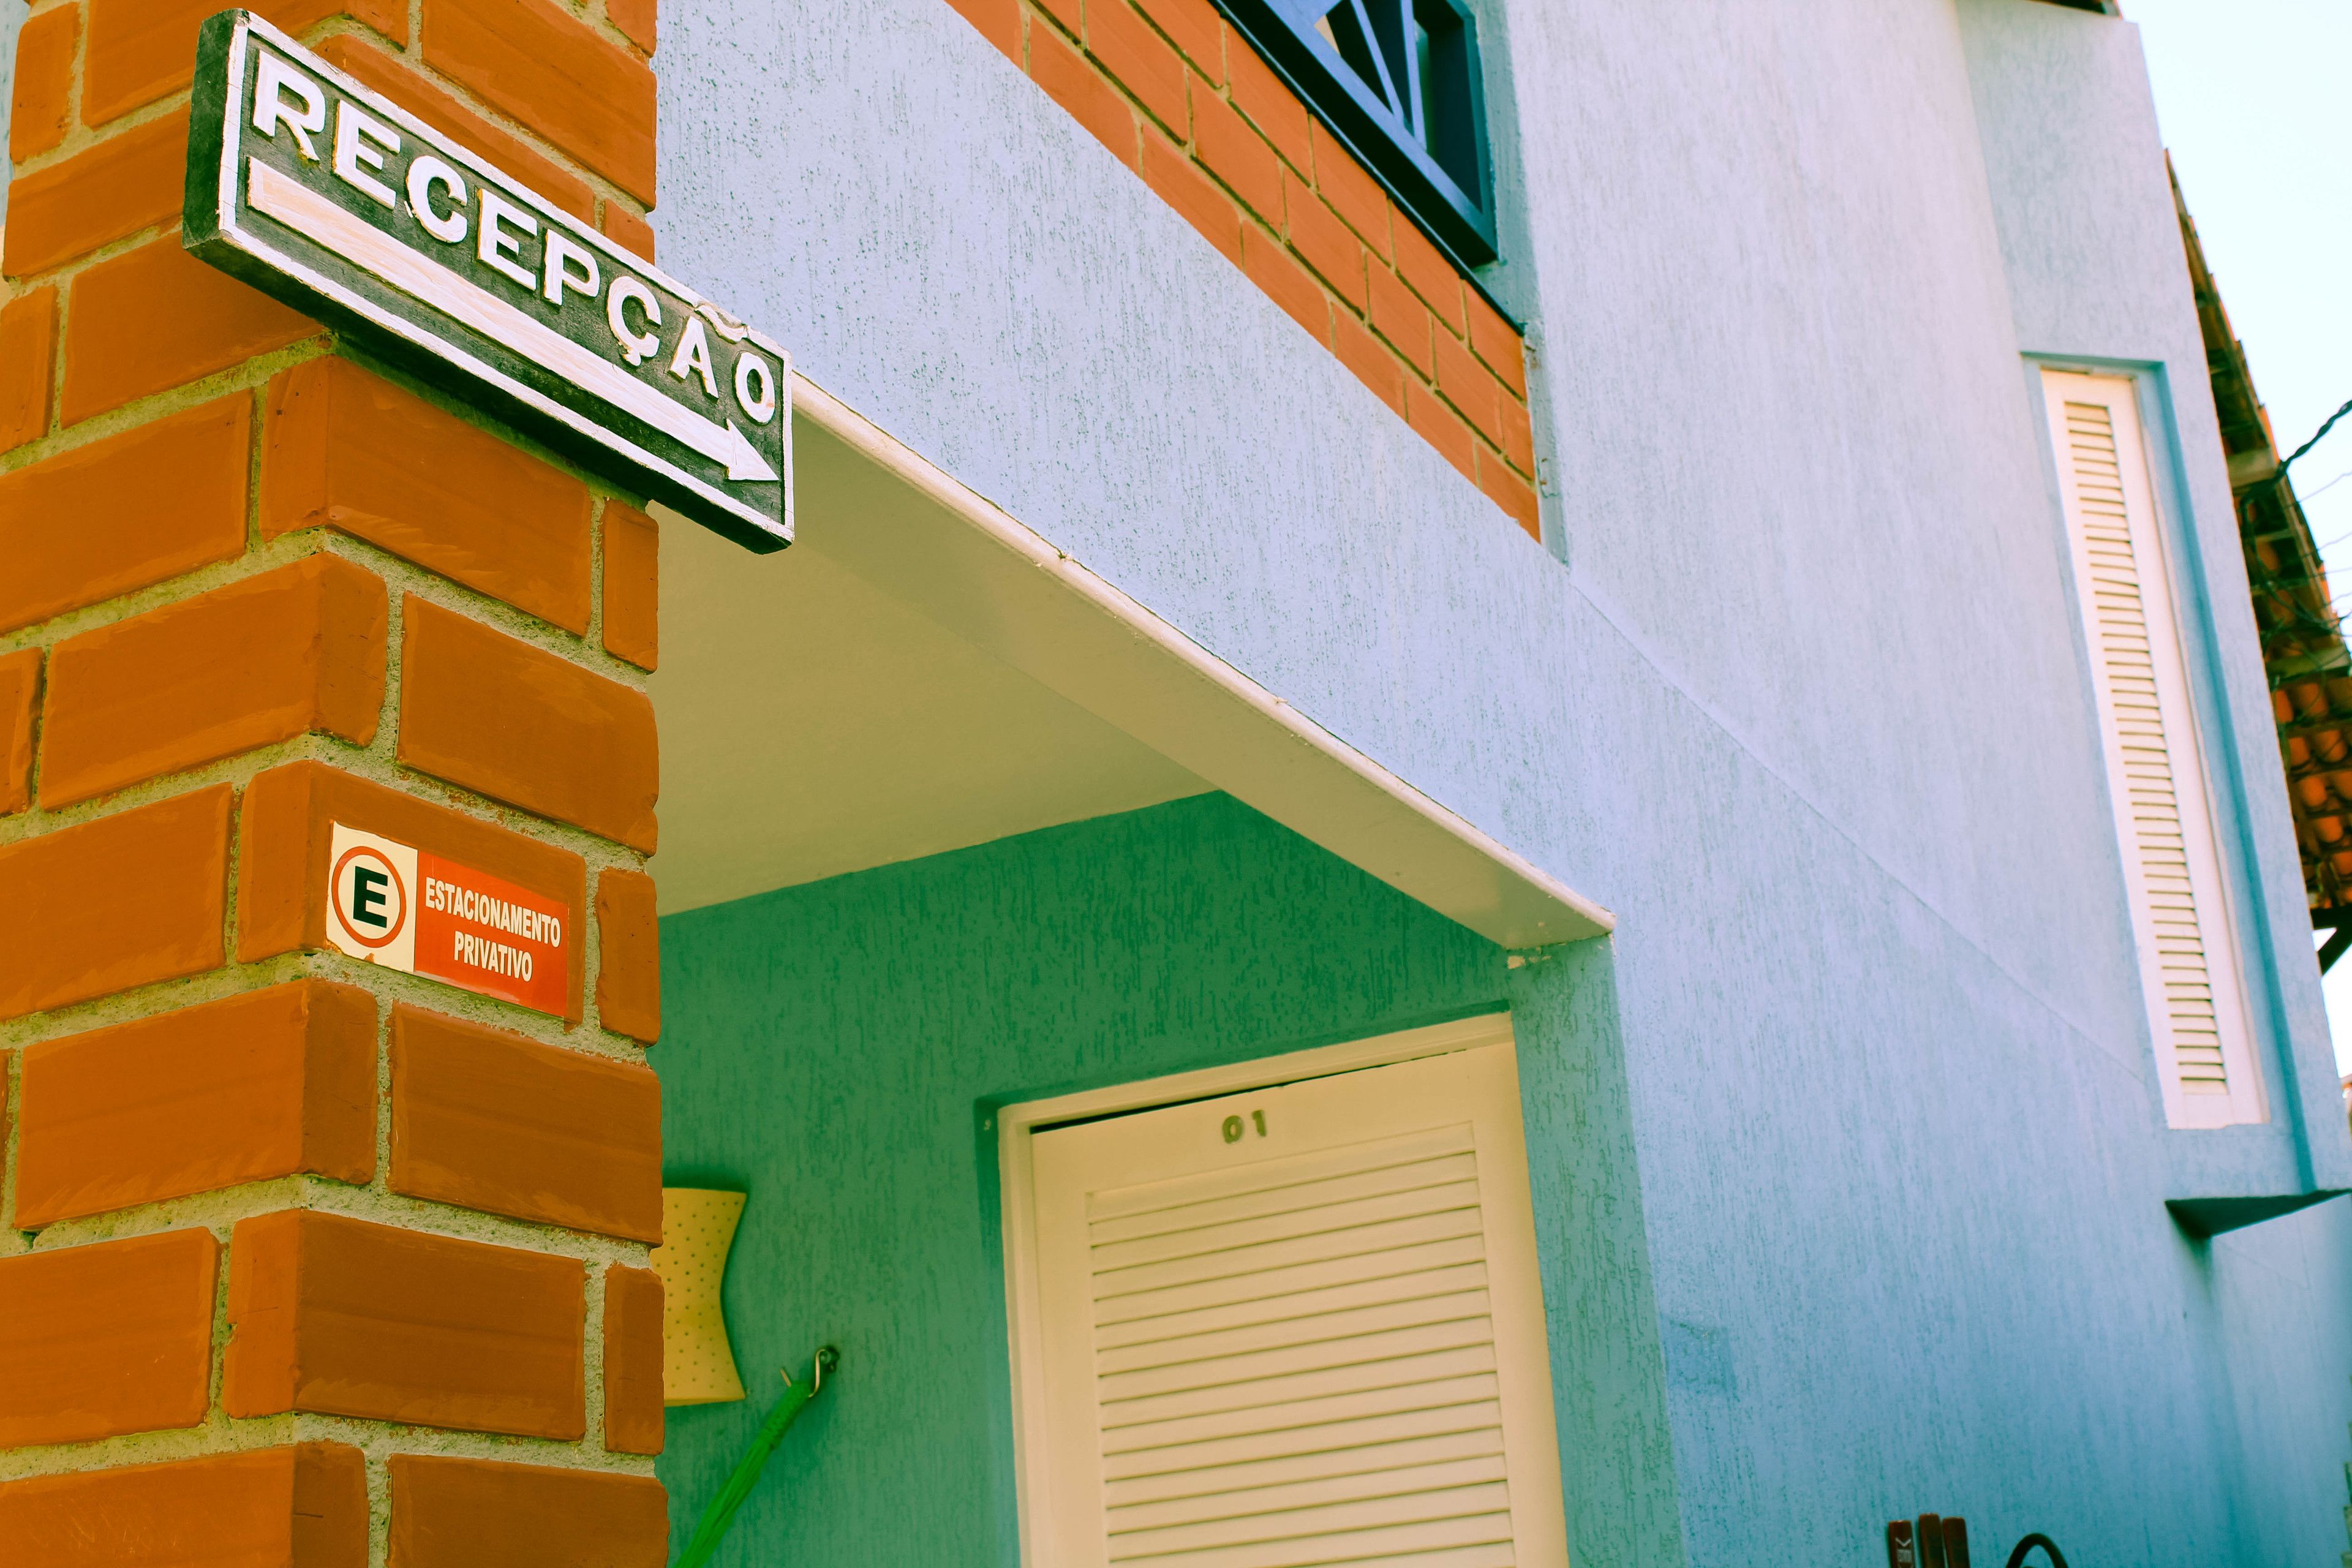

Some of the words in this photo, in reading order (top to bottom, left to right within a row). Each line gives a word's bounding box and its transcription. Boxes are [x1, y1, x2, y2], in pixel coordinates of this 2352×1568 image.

[252, 50, 775, 425] RECEPÇÃO
[425, 876, 561, 948] ESTACIONAMENTO
[454, 930, 533, 982] PRIVATIVO
[1222, 1110, 1267, 1144] 01
